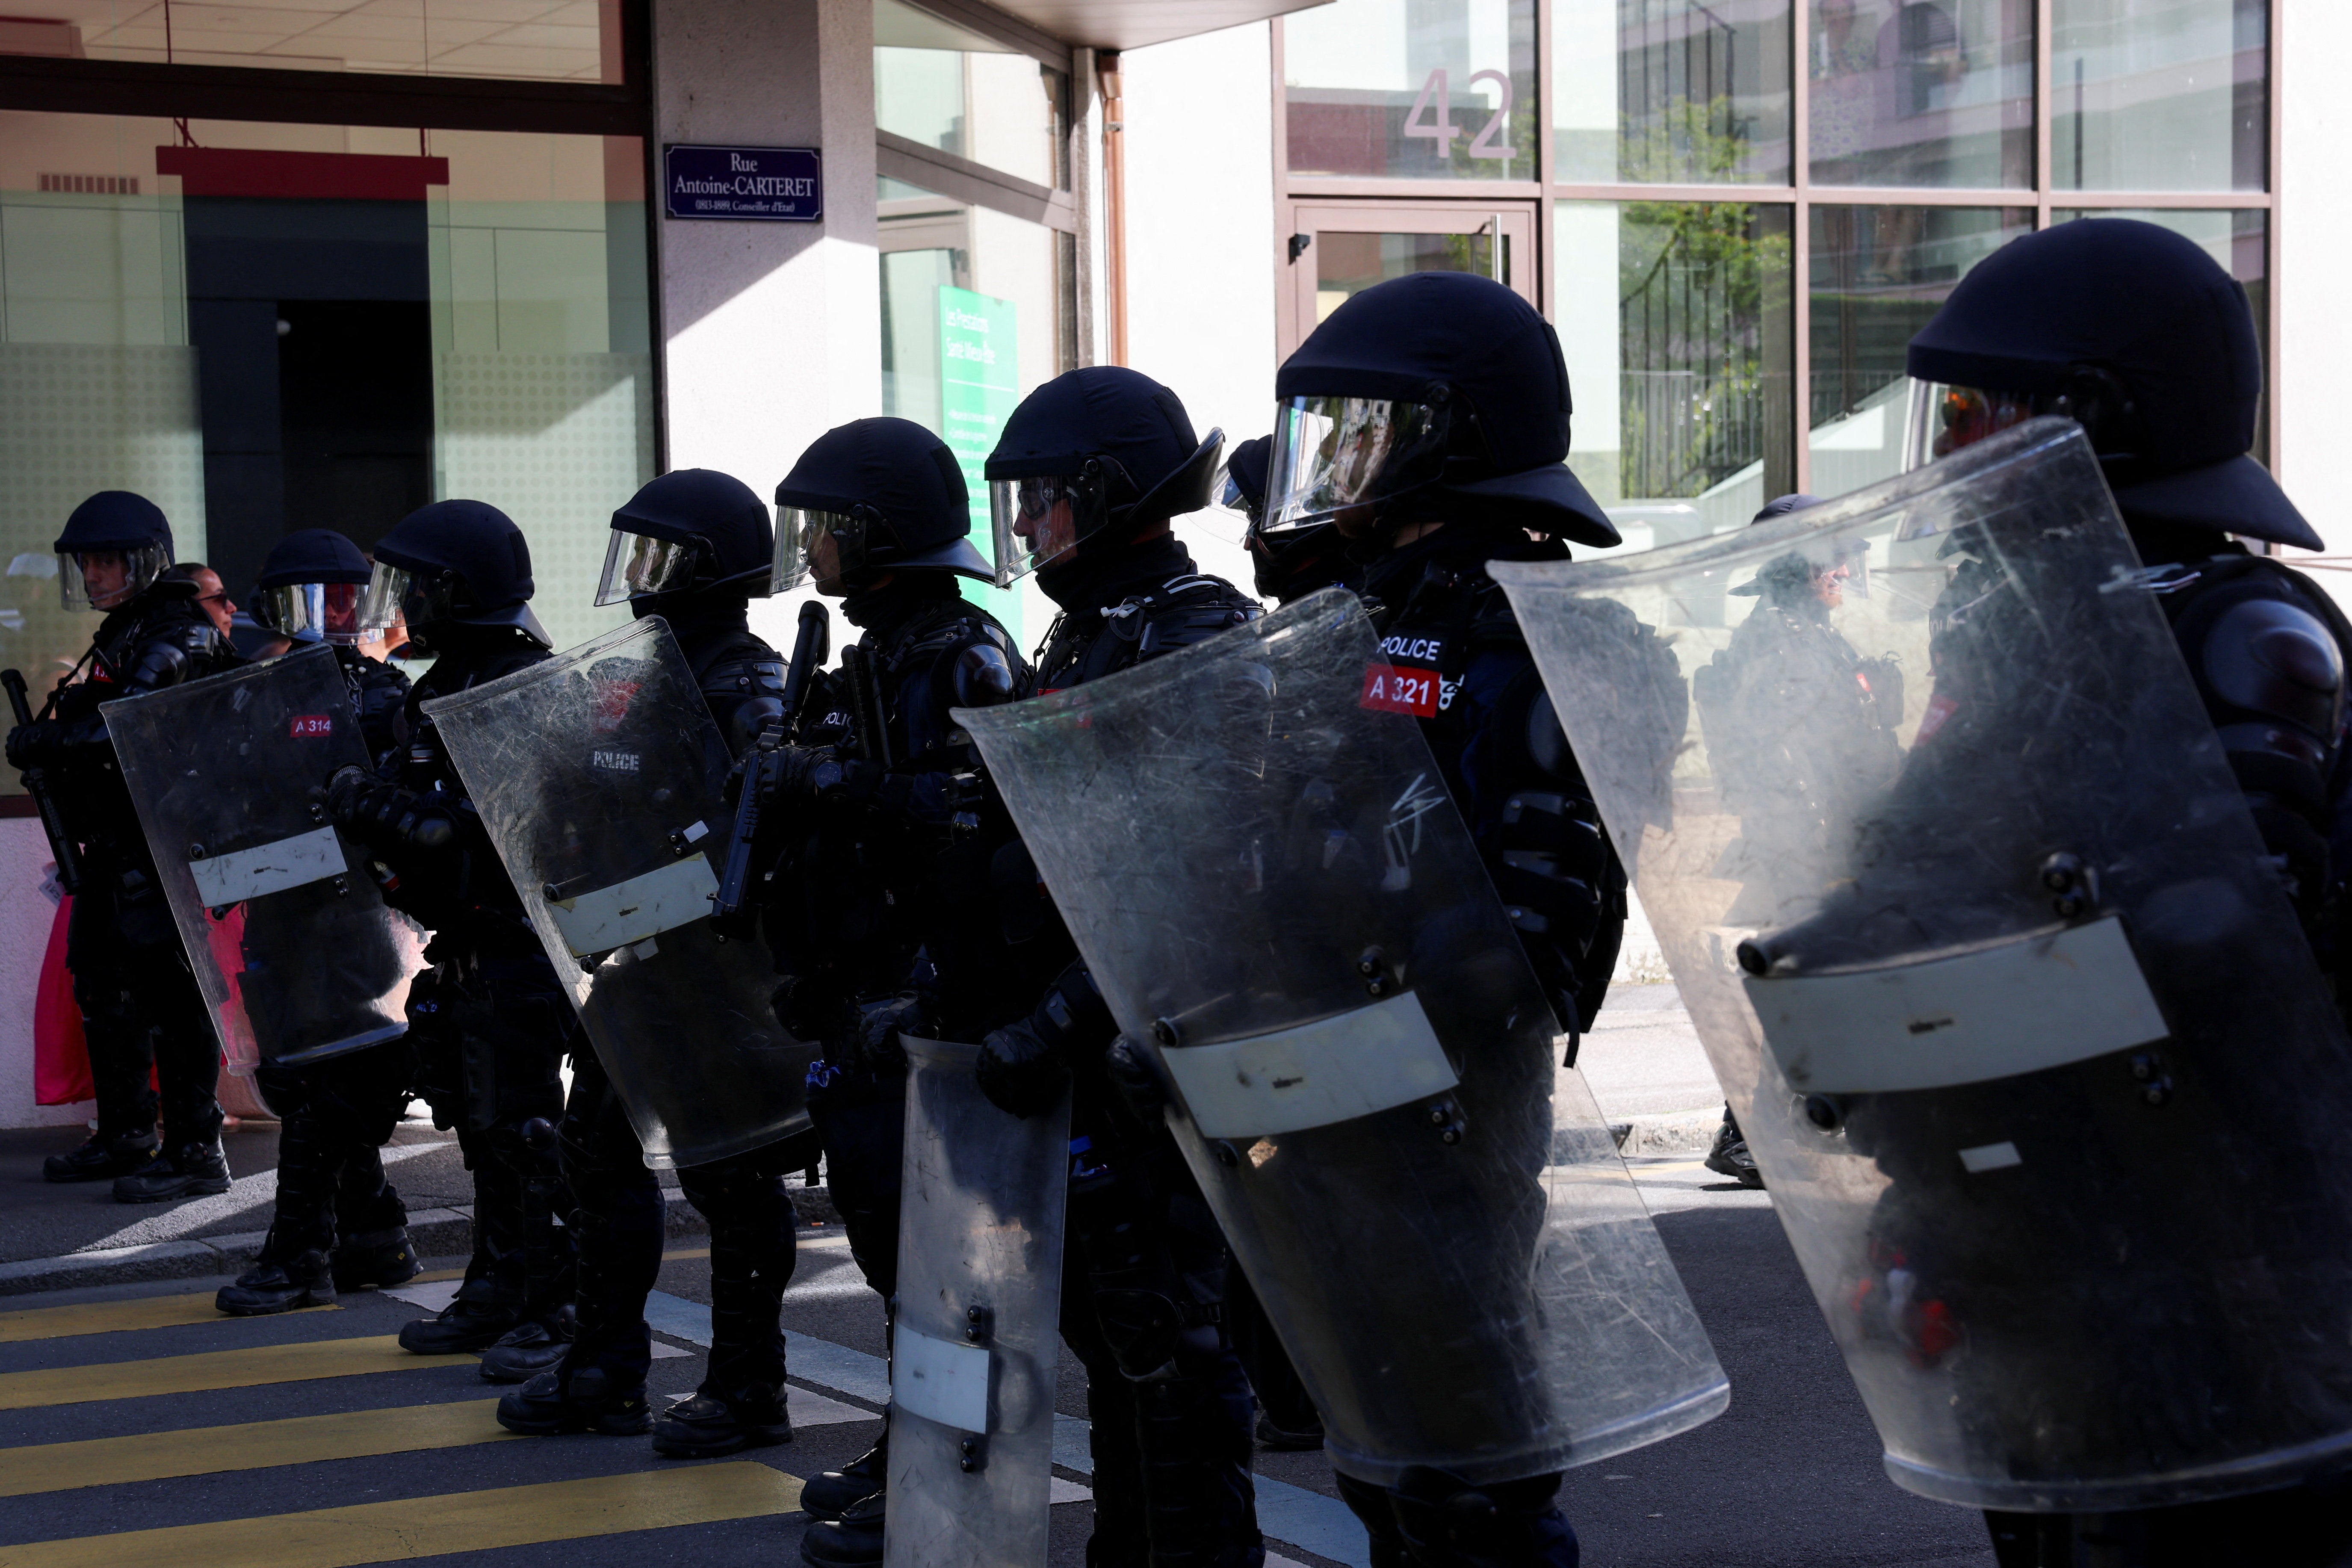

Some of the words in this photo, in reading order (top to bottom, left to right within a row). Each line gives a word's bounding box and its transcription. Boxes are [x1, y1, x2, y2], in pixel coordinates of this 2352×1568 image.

[1404, 69, 1516, 158] 42
[730, 153, 758, 172] Rue
[674, 174, 814, 197] Antoine-CARTERET
[732, 201, 770, 211] Conseiller
[1377, 636, 1441, 661] POLICE
[1369, 674, 1384, 699] A
[1392, 676, 1430, 705] 321
[295, 721, 304, 732] A
[309, 720, 331, 732] 314
[823, 712, 854, 728] POLIC
[594, 750, 639, 771] POLICE
